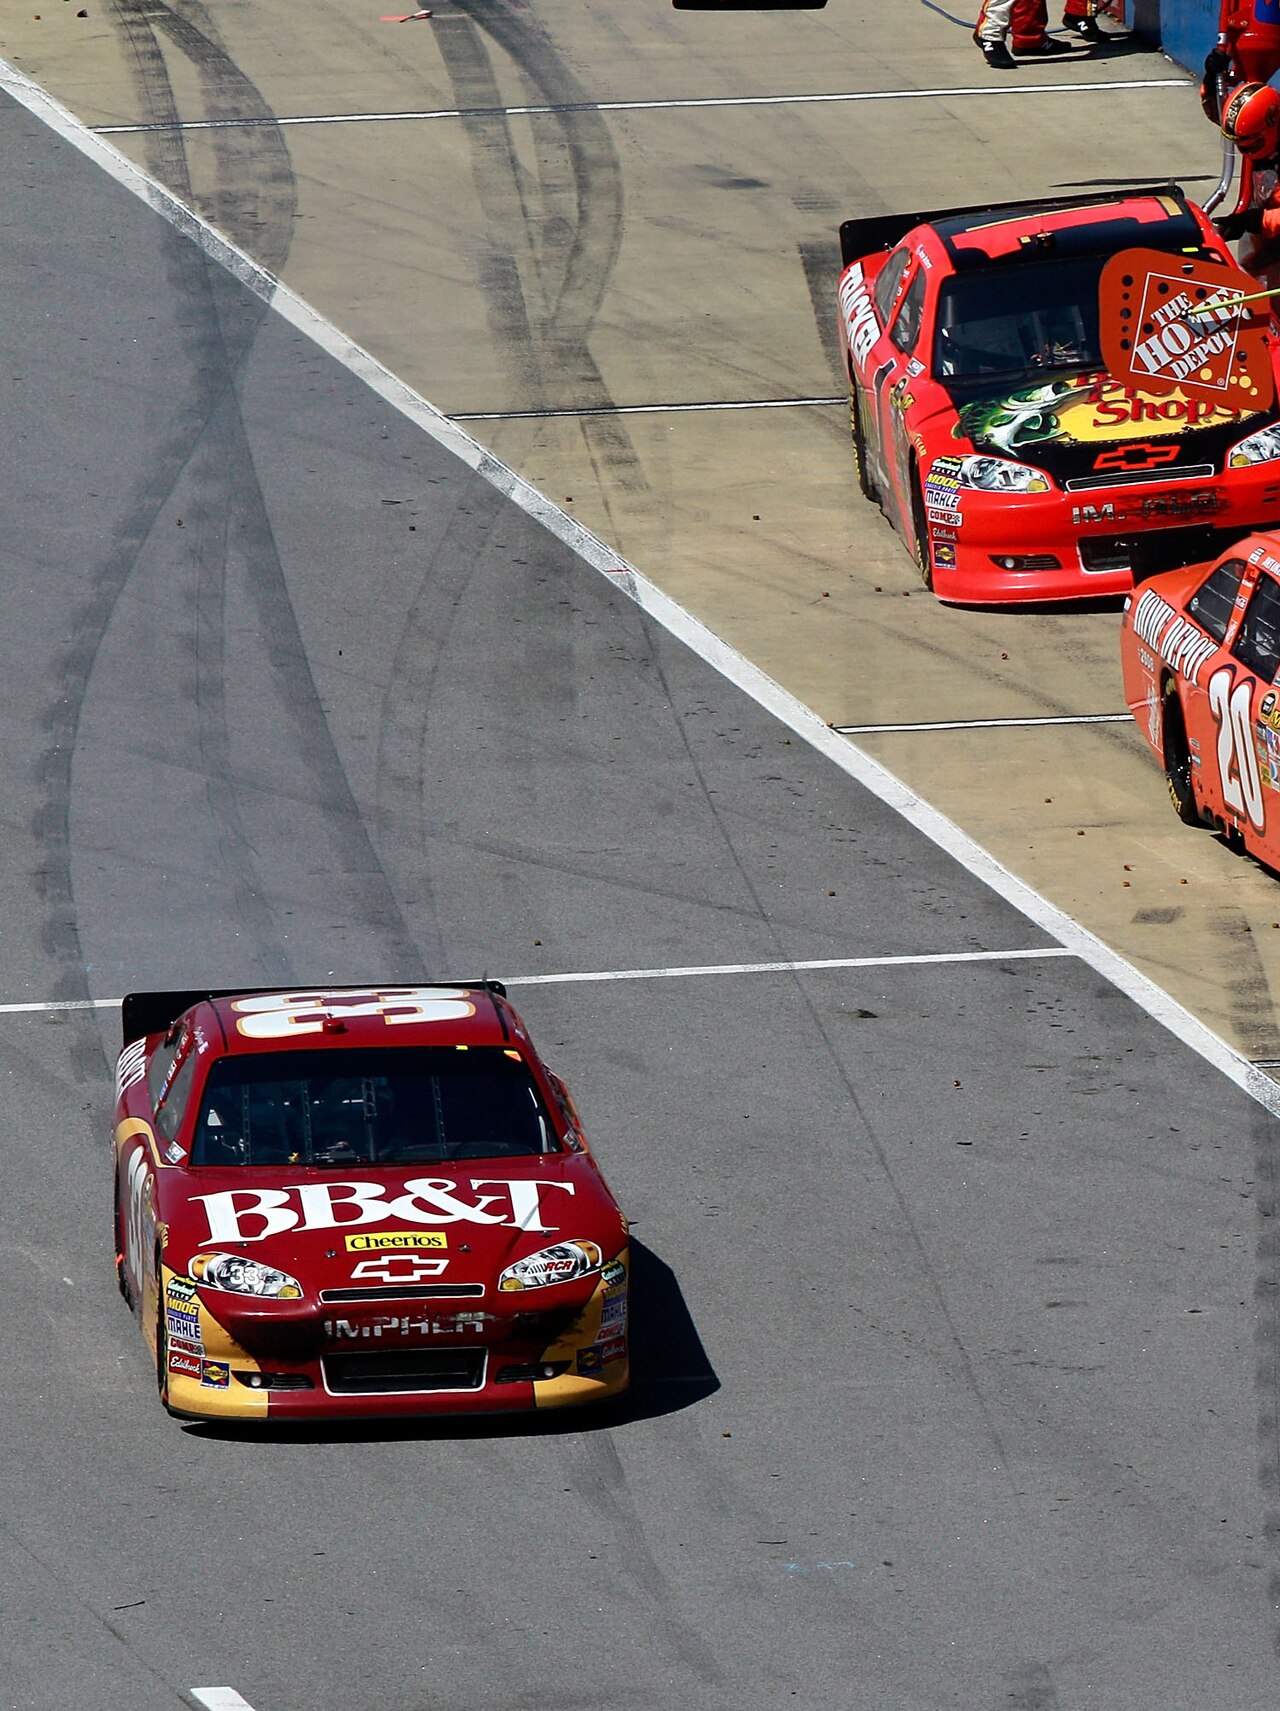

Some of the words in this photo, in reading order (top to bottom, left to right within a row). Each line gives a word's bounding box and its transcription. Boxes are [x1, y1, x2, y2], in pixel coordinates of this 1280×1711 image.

[839, 262, 882, 374] TRACKER
[1150, 291, 1194, 328] THE
[1134, 288, 1240, 376] HOME
[1169, 326, 1235, 380] DEPOT
[927, 473, 960, 488] MOOG
[926, 490, 960, 508] MAHLE
[1072, 493, 1218, 524] IMALA
[1134, 588, 1176, 653] HOME
[1161, 615, 1218, 688] DEPOT
[1209, 671, 1265, 829] 20
[187, 1178, 575, 1247] BB&T
[350, 1234, 442, 1249] Cheerios
[230, 1264, 260, 1285] 33
[546, 1261, 573, 1271] RCR
[168, 1298, 199, 1316] MOOG
[168, 1320, 200, 1339] MAHLE
